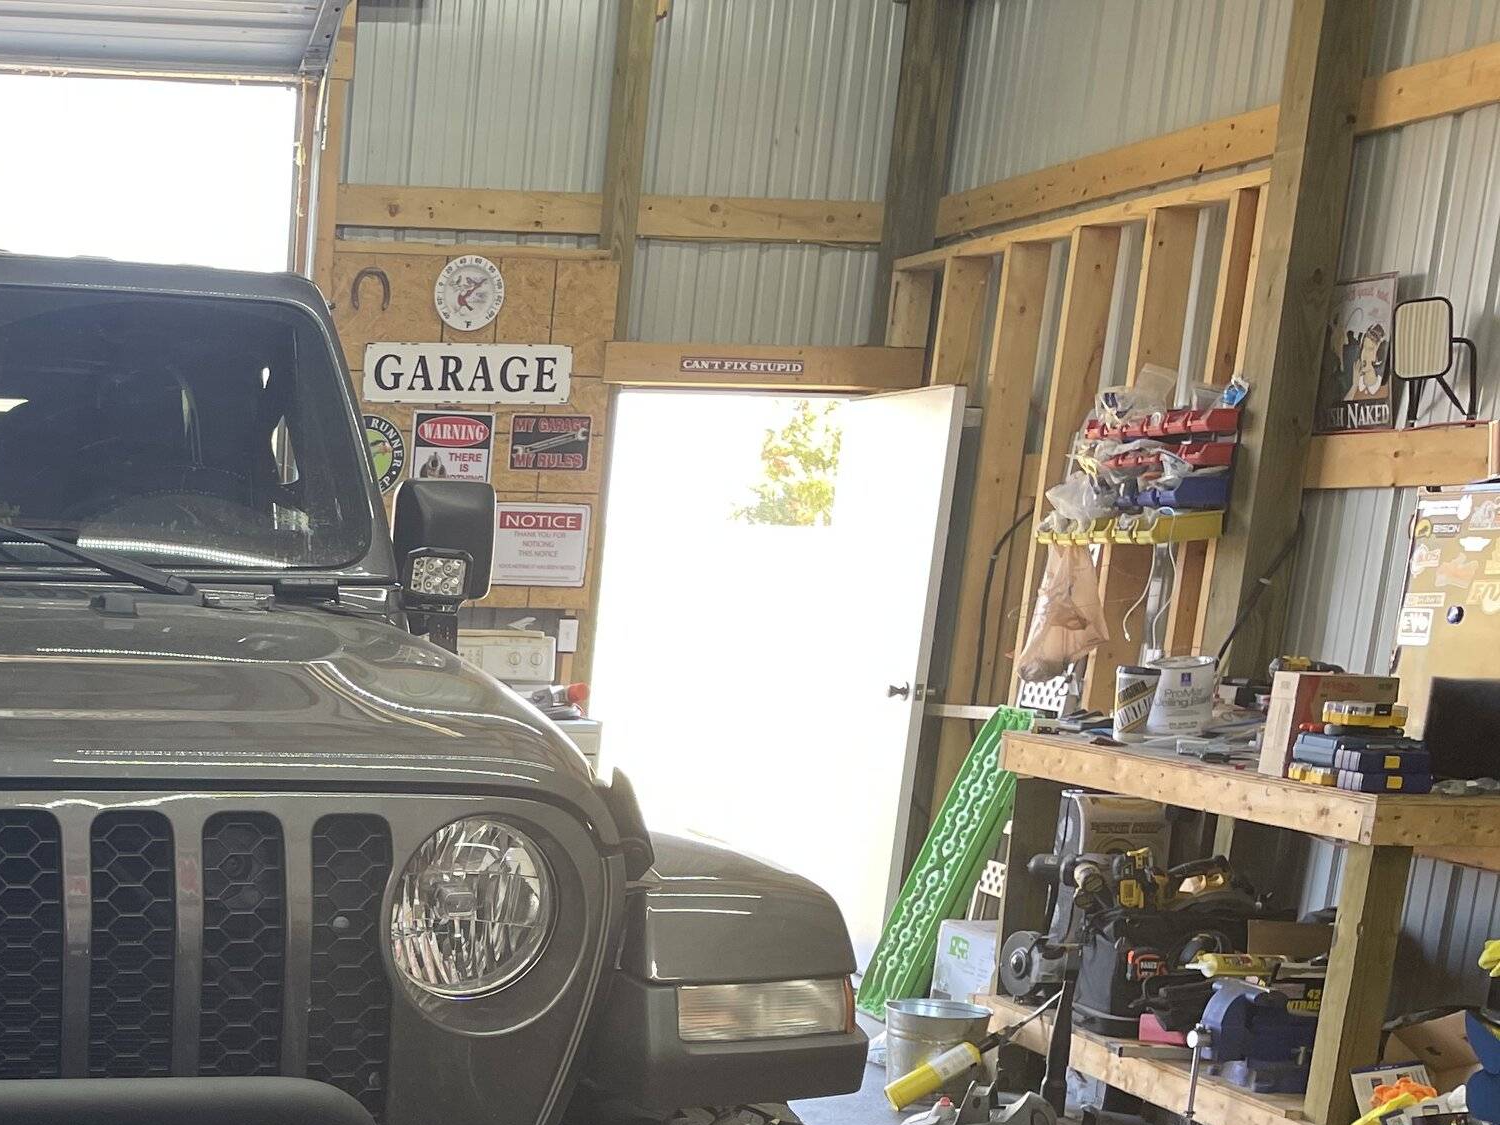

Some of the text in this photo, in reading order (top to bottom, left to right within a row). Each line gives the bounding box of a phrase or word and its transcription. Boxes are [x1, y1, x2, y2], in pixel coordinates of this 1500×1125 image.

[373, 353, 558, 393] GARAGE
[682, 360, 802, 372] CAN'T FIX STUPID
[421, 422, 485, 441] WARNING
[513, 418, 589, 433] MY GARAGE
[370, 417, 403, 468] RUNNER
[448, 452, 483, 463] THERE
[512, 453, 583, 468] MY RULES
[459, 463, 469, 472] IS
[505, 514, 577, 529] NOTICE
